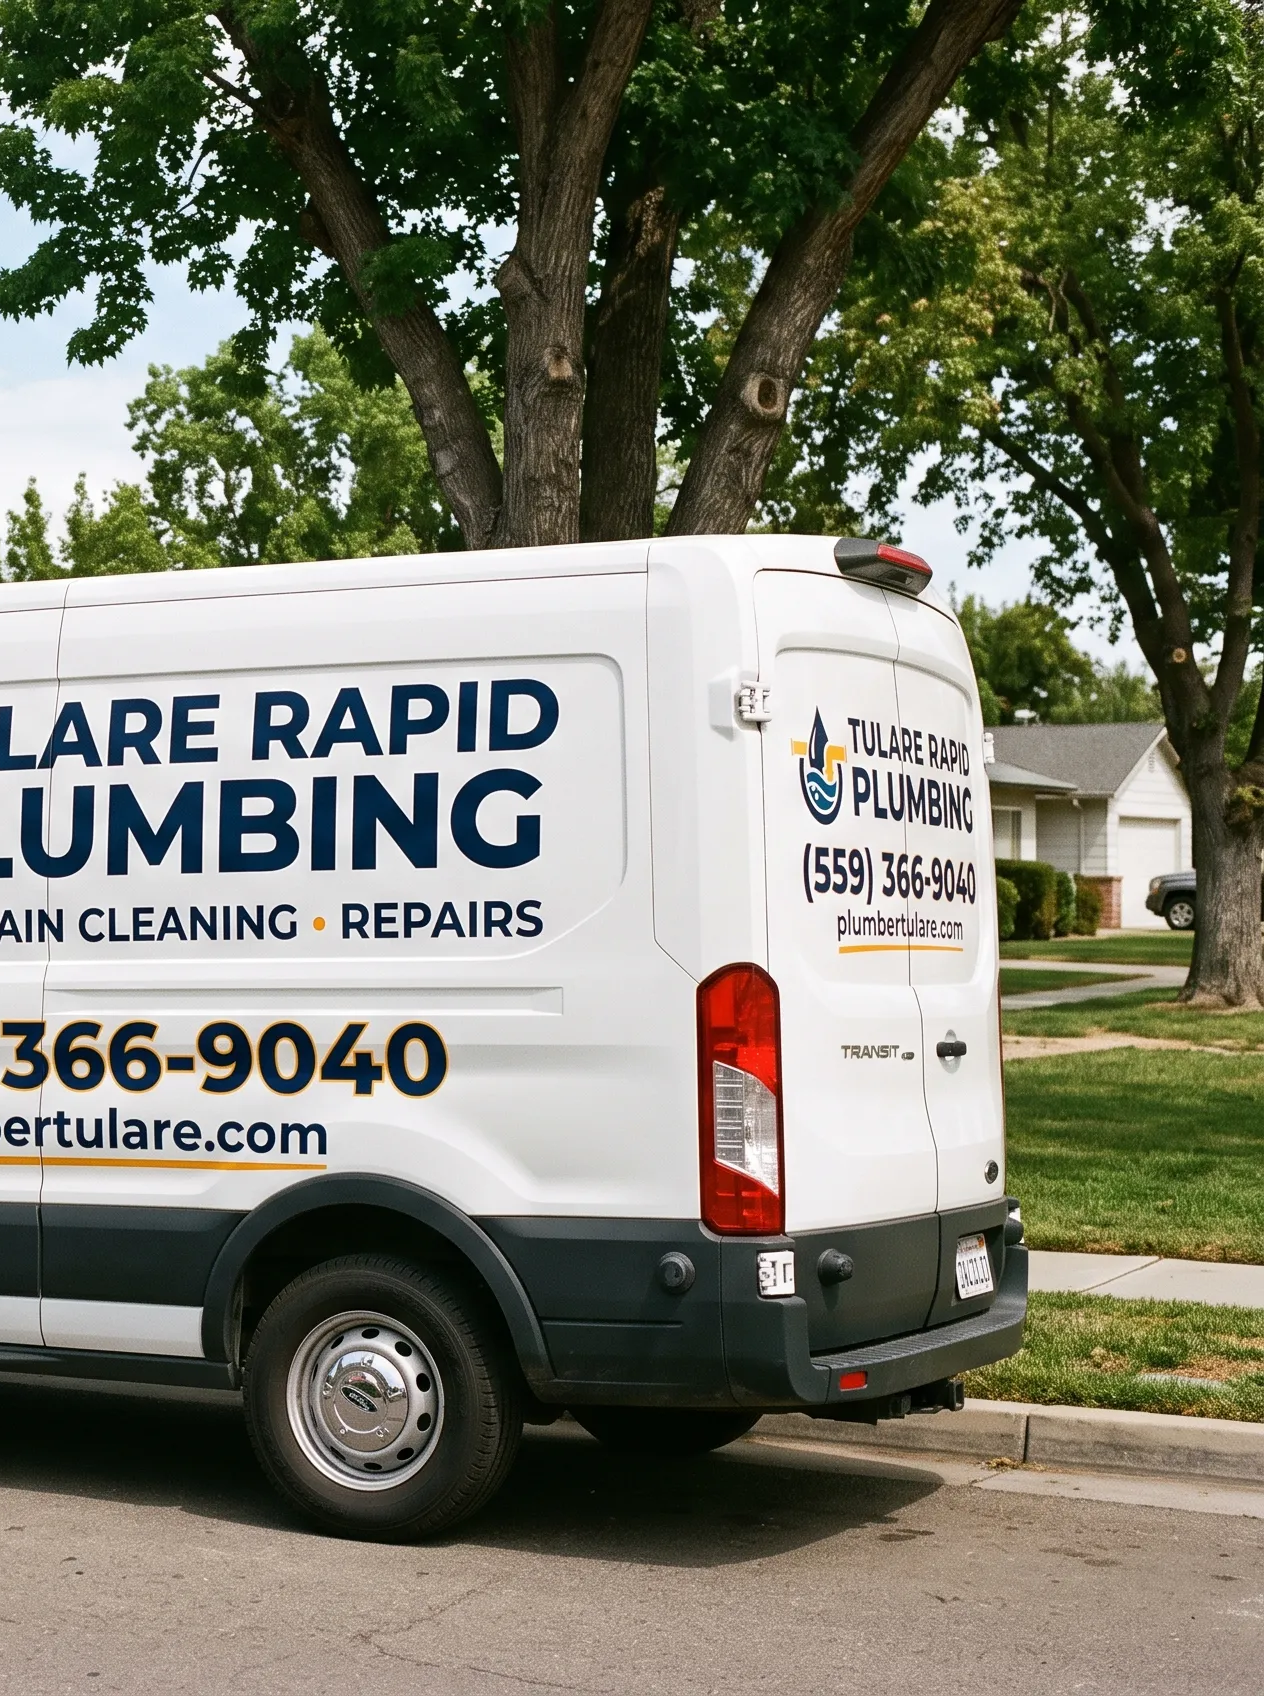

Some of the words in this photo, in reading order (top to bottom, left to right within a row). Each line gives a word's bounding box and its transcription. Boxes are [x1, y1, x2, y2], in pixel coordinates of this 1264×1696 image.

[251, 678, 560, 761] RAPID
[847, 717, 924, 766] TULARE
[928, 733, 970, 777] RAPID
[852, 766, 973, 834] PLUMBING
[803, 843, 874, 905] (559)
[881, 851, 976, 905] 366-9040
[78, 903, 297, 943] CLEANING
[341, 899, 544, 940] REPAIRS
[837, 908, 963, 942] plumbertulare.com
[0, 1020, 450, 1098] 366-9040
[840, 1044, 900, 1060] TRANSIT
